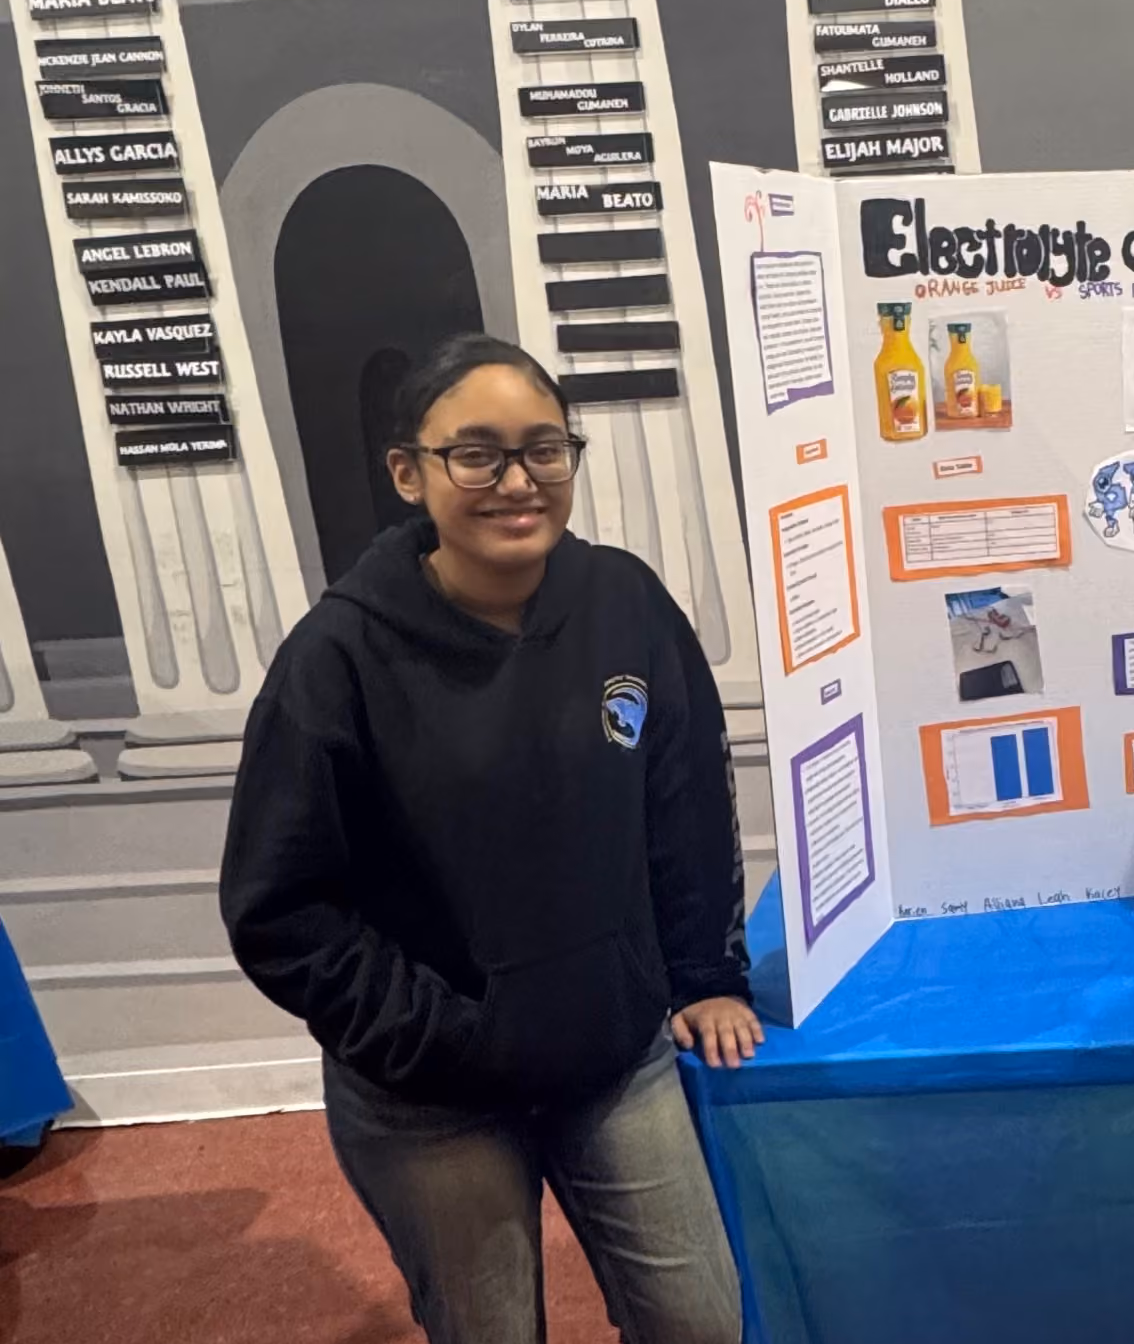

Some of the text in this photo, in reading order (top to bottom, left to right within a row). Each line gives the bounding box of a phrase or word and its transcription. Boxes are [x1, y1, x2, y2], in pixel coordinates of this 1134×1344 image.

[816, 24, 880, 36] FATOUMATA
[820, 58, 885, 76] SHANTELLE
[884, 70, 940, 84] HOLLAND
[829, 102, 943, 122] GABRIELLE JOHNSON
[54, 143, 178, 165] ALLYS GARCIA
[825, 136, 945, 162] ELIJAH MAJOR
[537, 185, 589, 200] MARIA
[602, 192, 653, 208] BEATO
[81, 241, 192, 263] ANGEL LEBRON
[860, 197, 1111, 287] Electrolyte
[88, 273, 205, 295] KENDALL PAUL
[914, 278, 979, 300] ORANGE
[1078, 281, 1123, 300] SPORTS
[93, 323, 213, 344] KAYLA VASQUEZ
[103, 361, 219, 379] RUSSELL WEST
[110, 400, 221, 416] NATHAN WRIGHT
